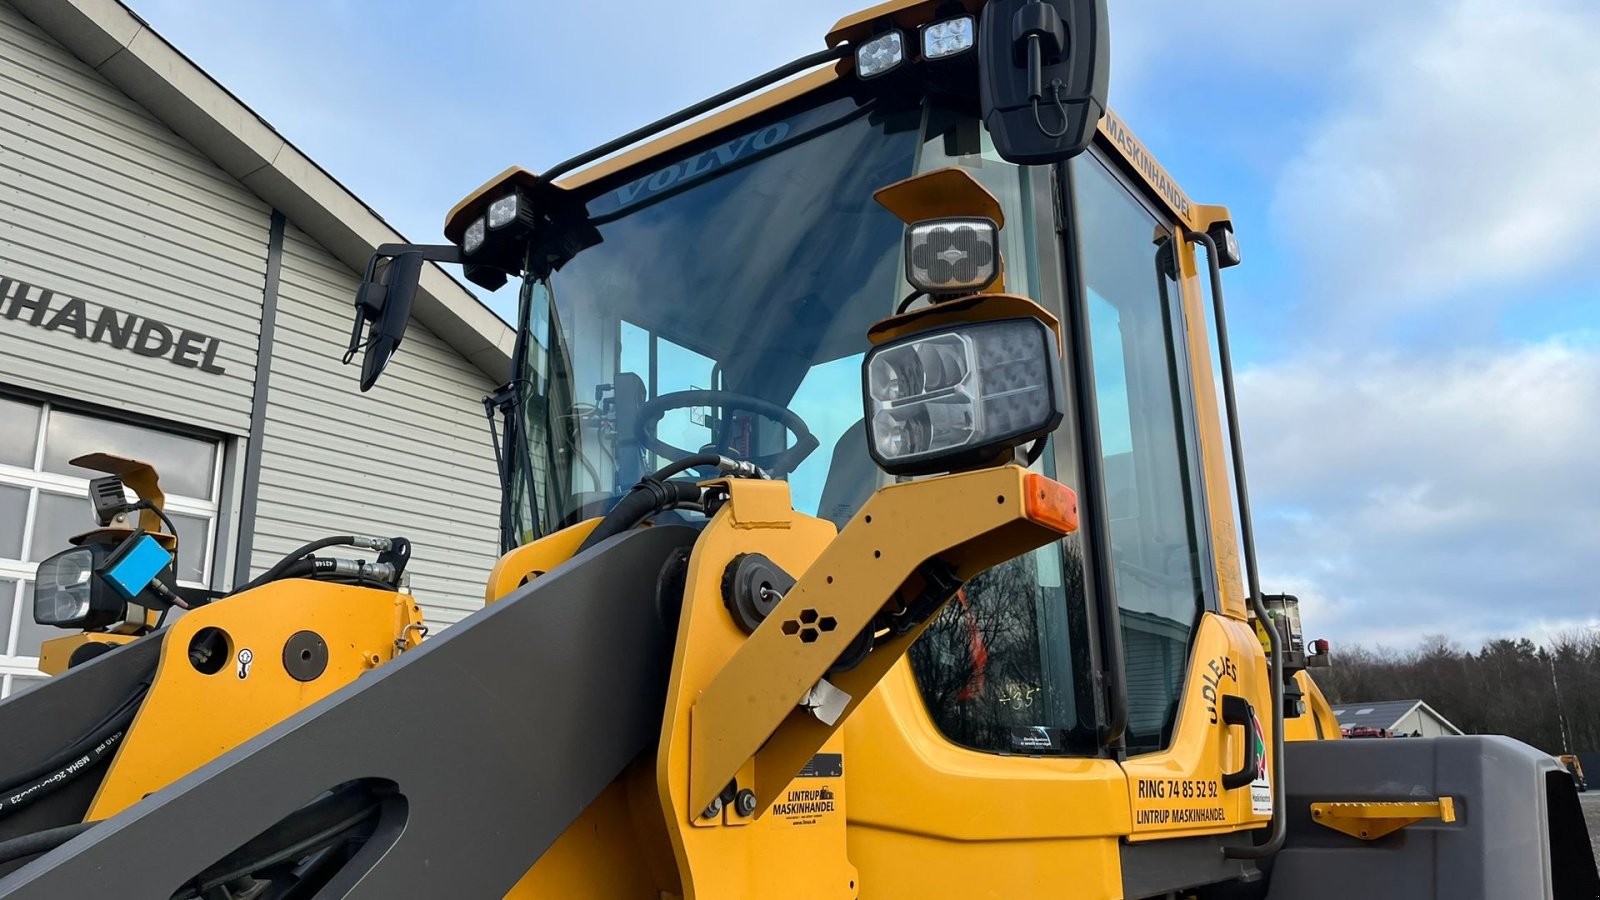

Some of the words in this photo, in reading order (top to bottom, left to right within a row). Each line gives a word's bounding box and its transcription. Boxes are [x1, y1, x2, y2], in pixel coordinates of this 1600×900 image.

[615, 122, 790, 205] VOLVO
[1106, 113, 1192, 222] MASKINHANDEL
[1202, 656, 1237, 725] UDLEJES
[67, 755, 90, 773] MSHA
[787, 790, 820, 802] LINTRUP
[1138, 780, 1165, 799] RING
[1168, 780, 1180, 799] 74
[1182, 780, 1194, 798] 85
[1196, 780, 1207, 798] 52
[1208, 780, 1218, 798] 92
[773, 801, 834, 815] MASKINHANDEL
[1137, 810, 1170, 824] LINTRUP
[1171, 808, 1226, 823] MASKINHANDEL
